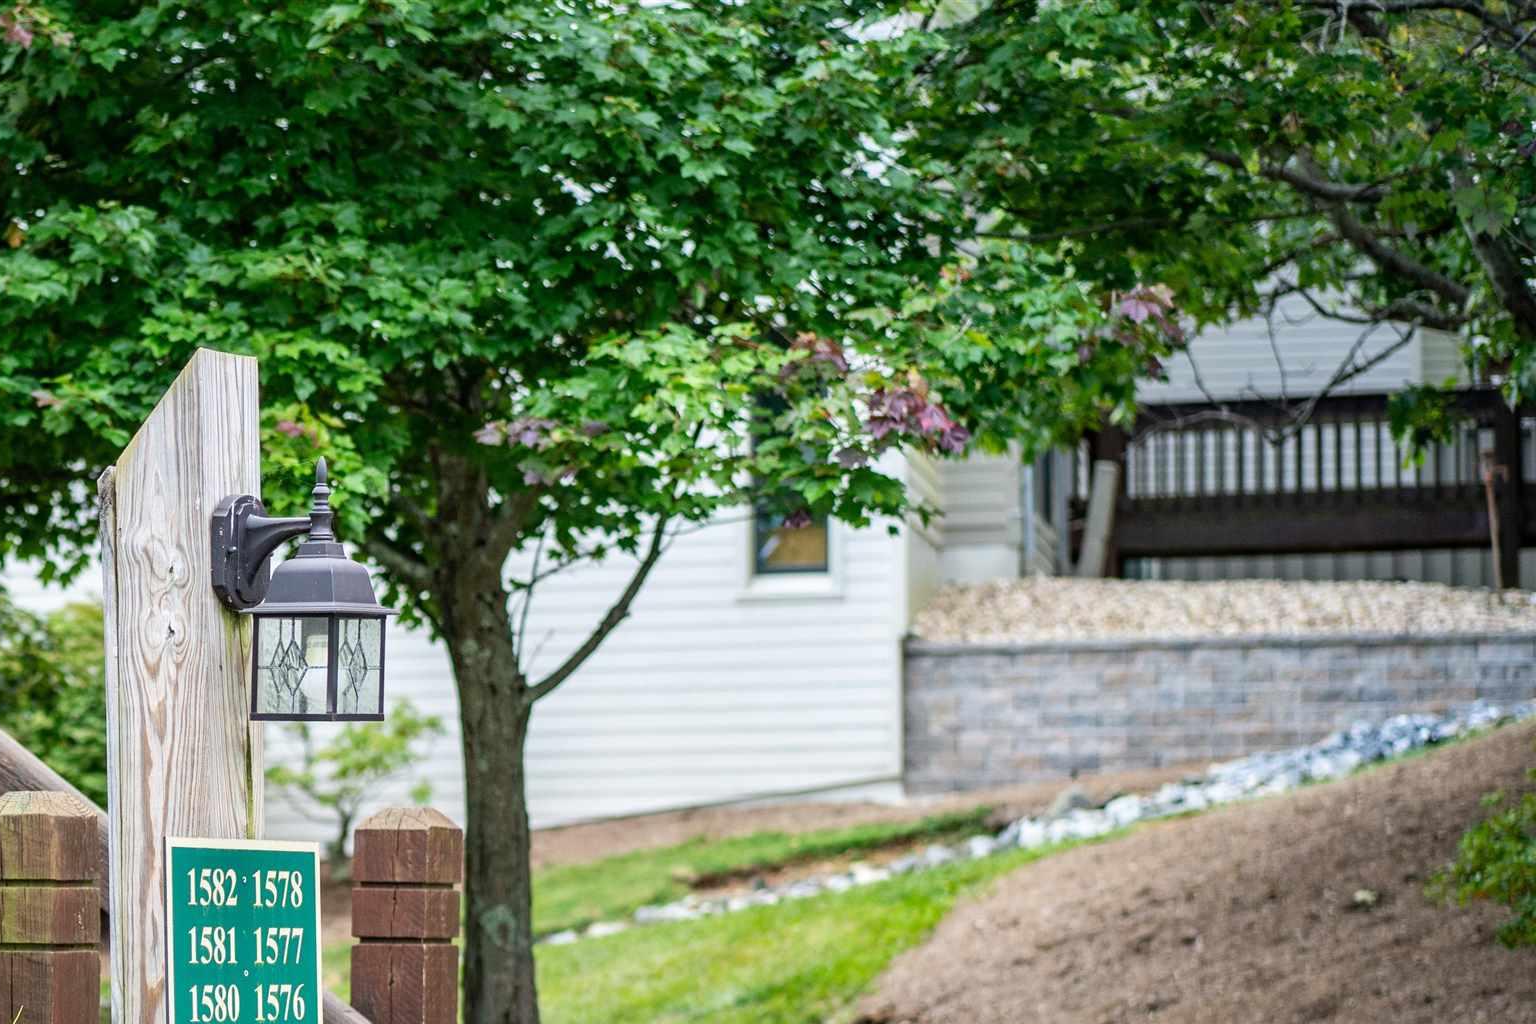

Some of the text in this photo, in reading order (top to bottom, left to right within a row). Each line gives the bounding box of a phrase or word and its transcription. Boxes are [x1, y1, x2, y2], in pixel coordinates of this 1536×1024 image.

[187, 868, 303, 908] 1582 1578
[188, 926, 304, 965] 1581 1577
[189, 983, 305, 1023] 1580 1576
